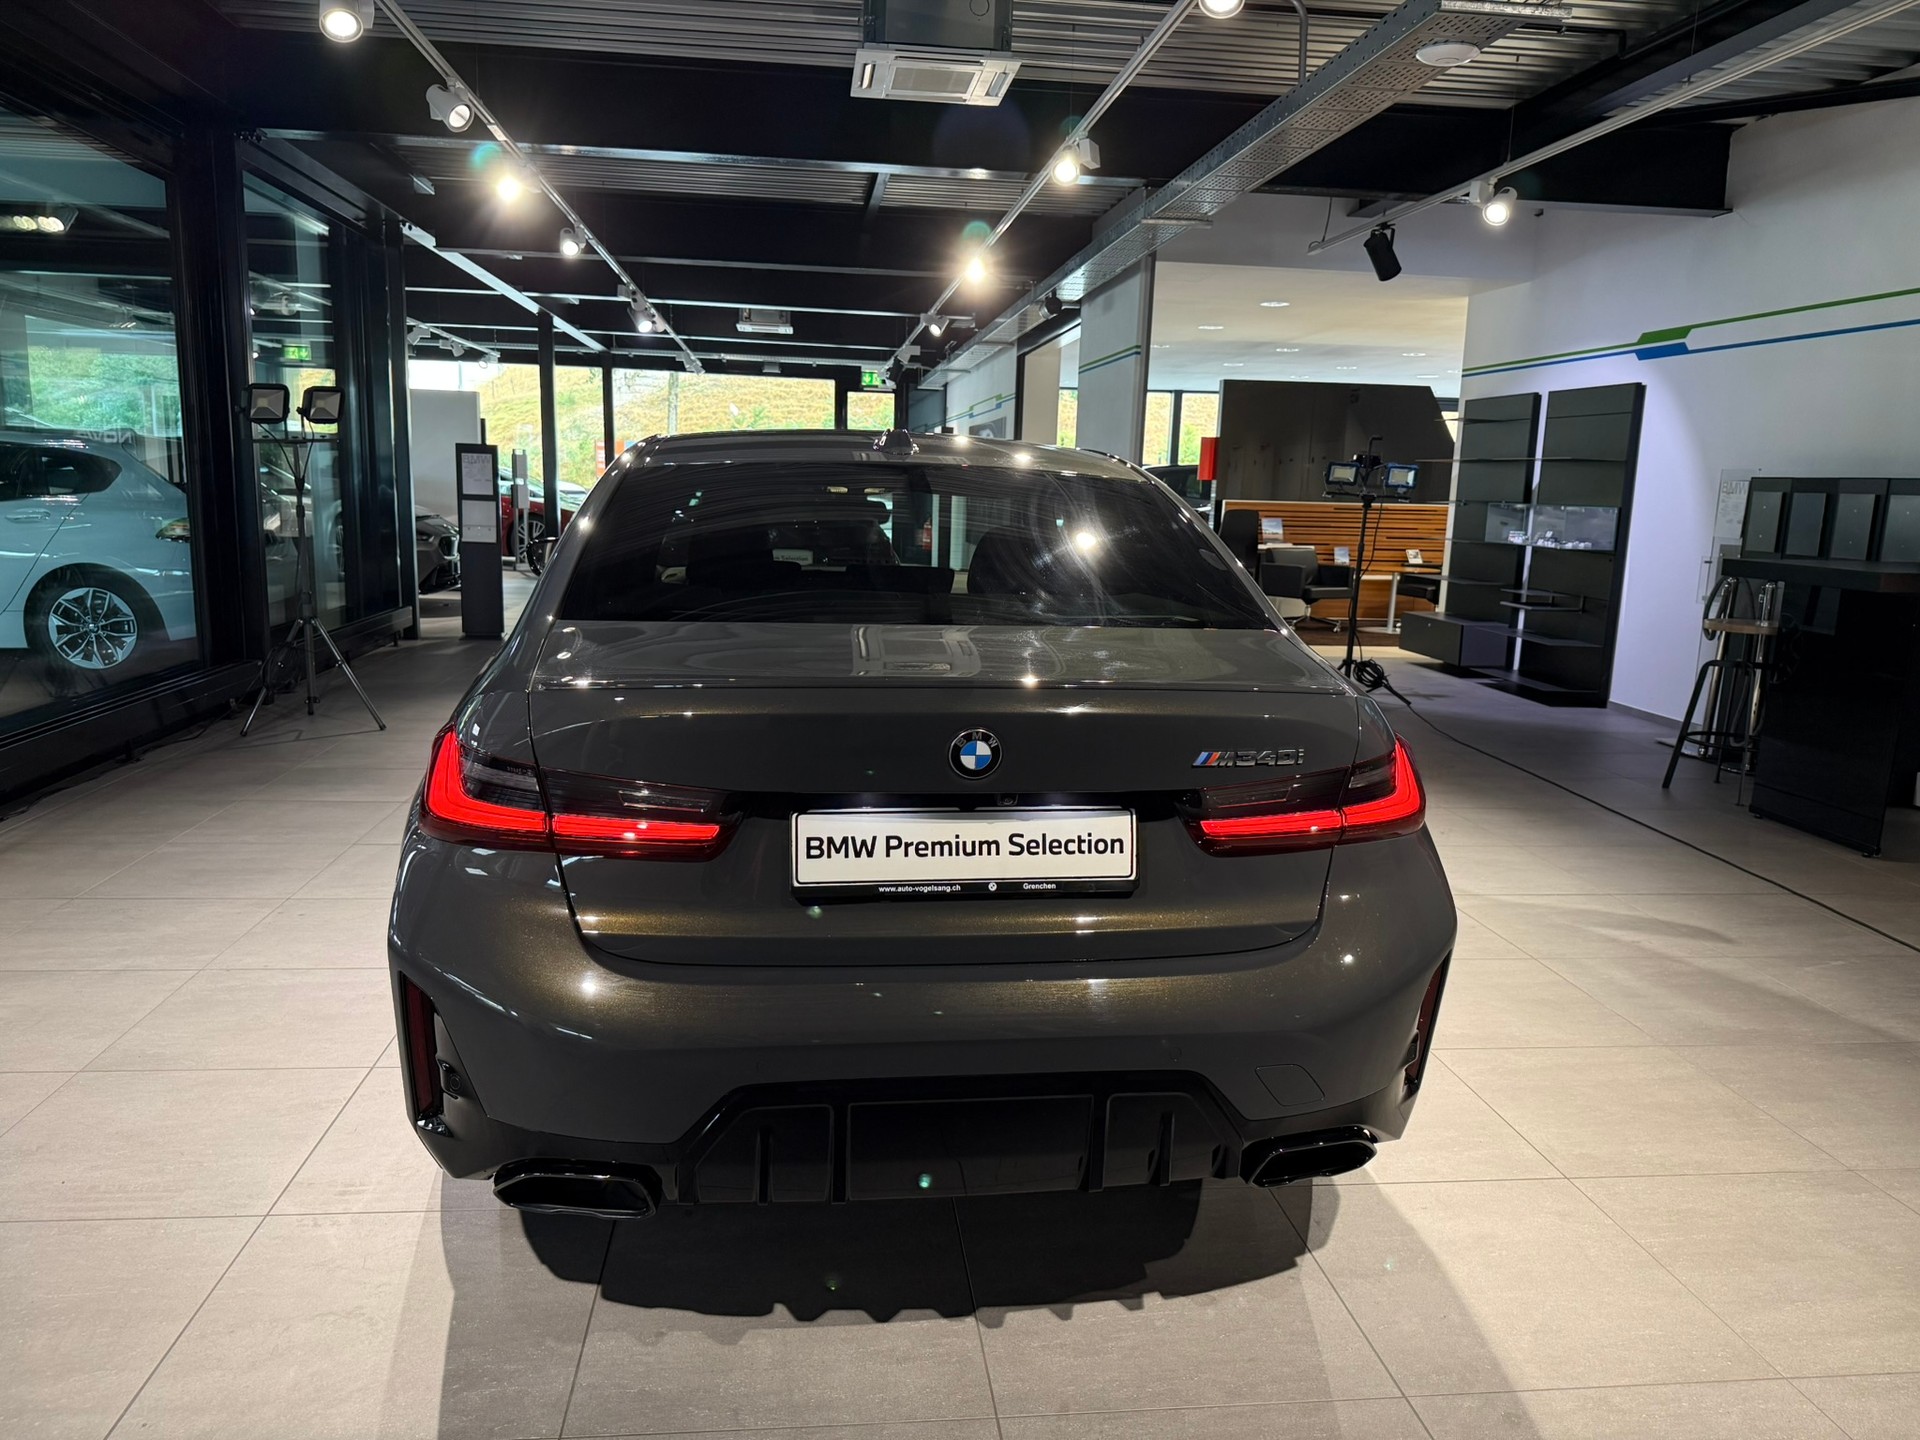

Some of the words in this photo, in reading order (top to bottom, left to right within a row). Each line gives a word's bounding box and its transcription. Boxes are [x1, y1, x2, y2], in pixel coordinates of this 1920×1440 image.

[955, 731, 998, 748] BMW
[1195, 749, 1304, 767] M340i
[806, 836, 877, 860] BMW
[885, 833, 1000, 858] Premium
[1008, 832, 1125, 856] Selection
[878, 884, 961, 893] www.auto-vogelsang.ch
